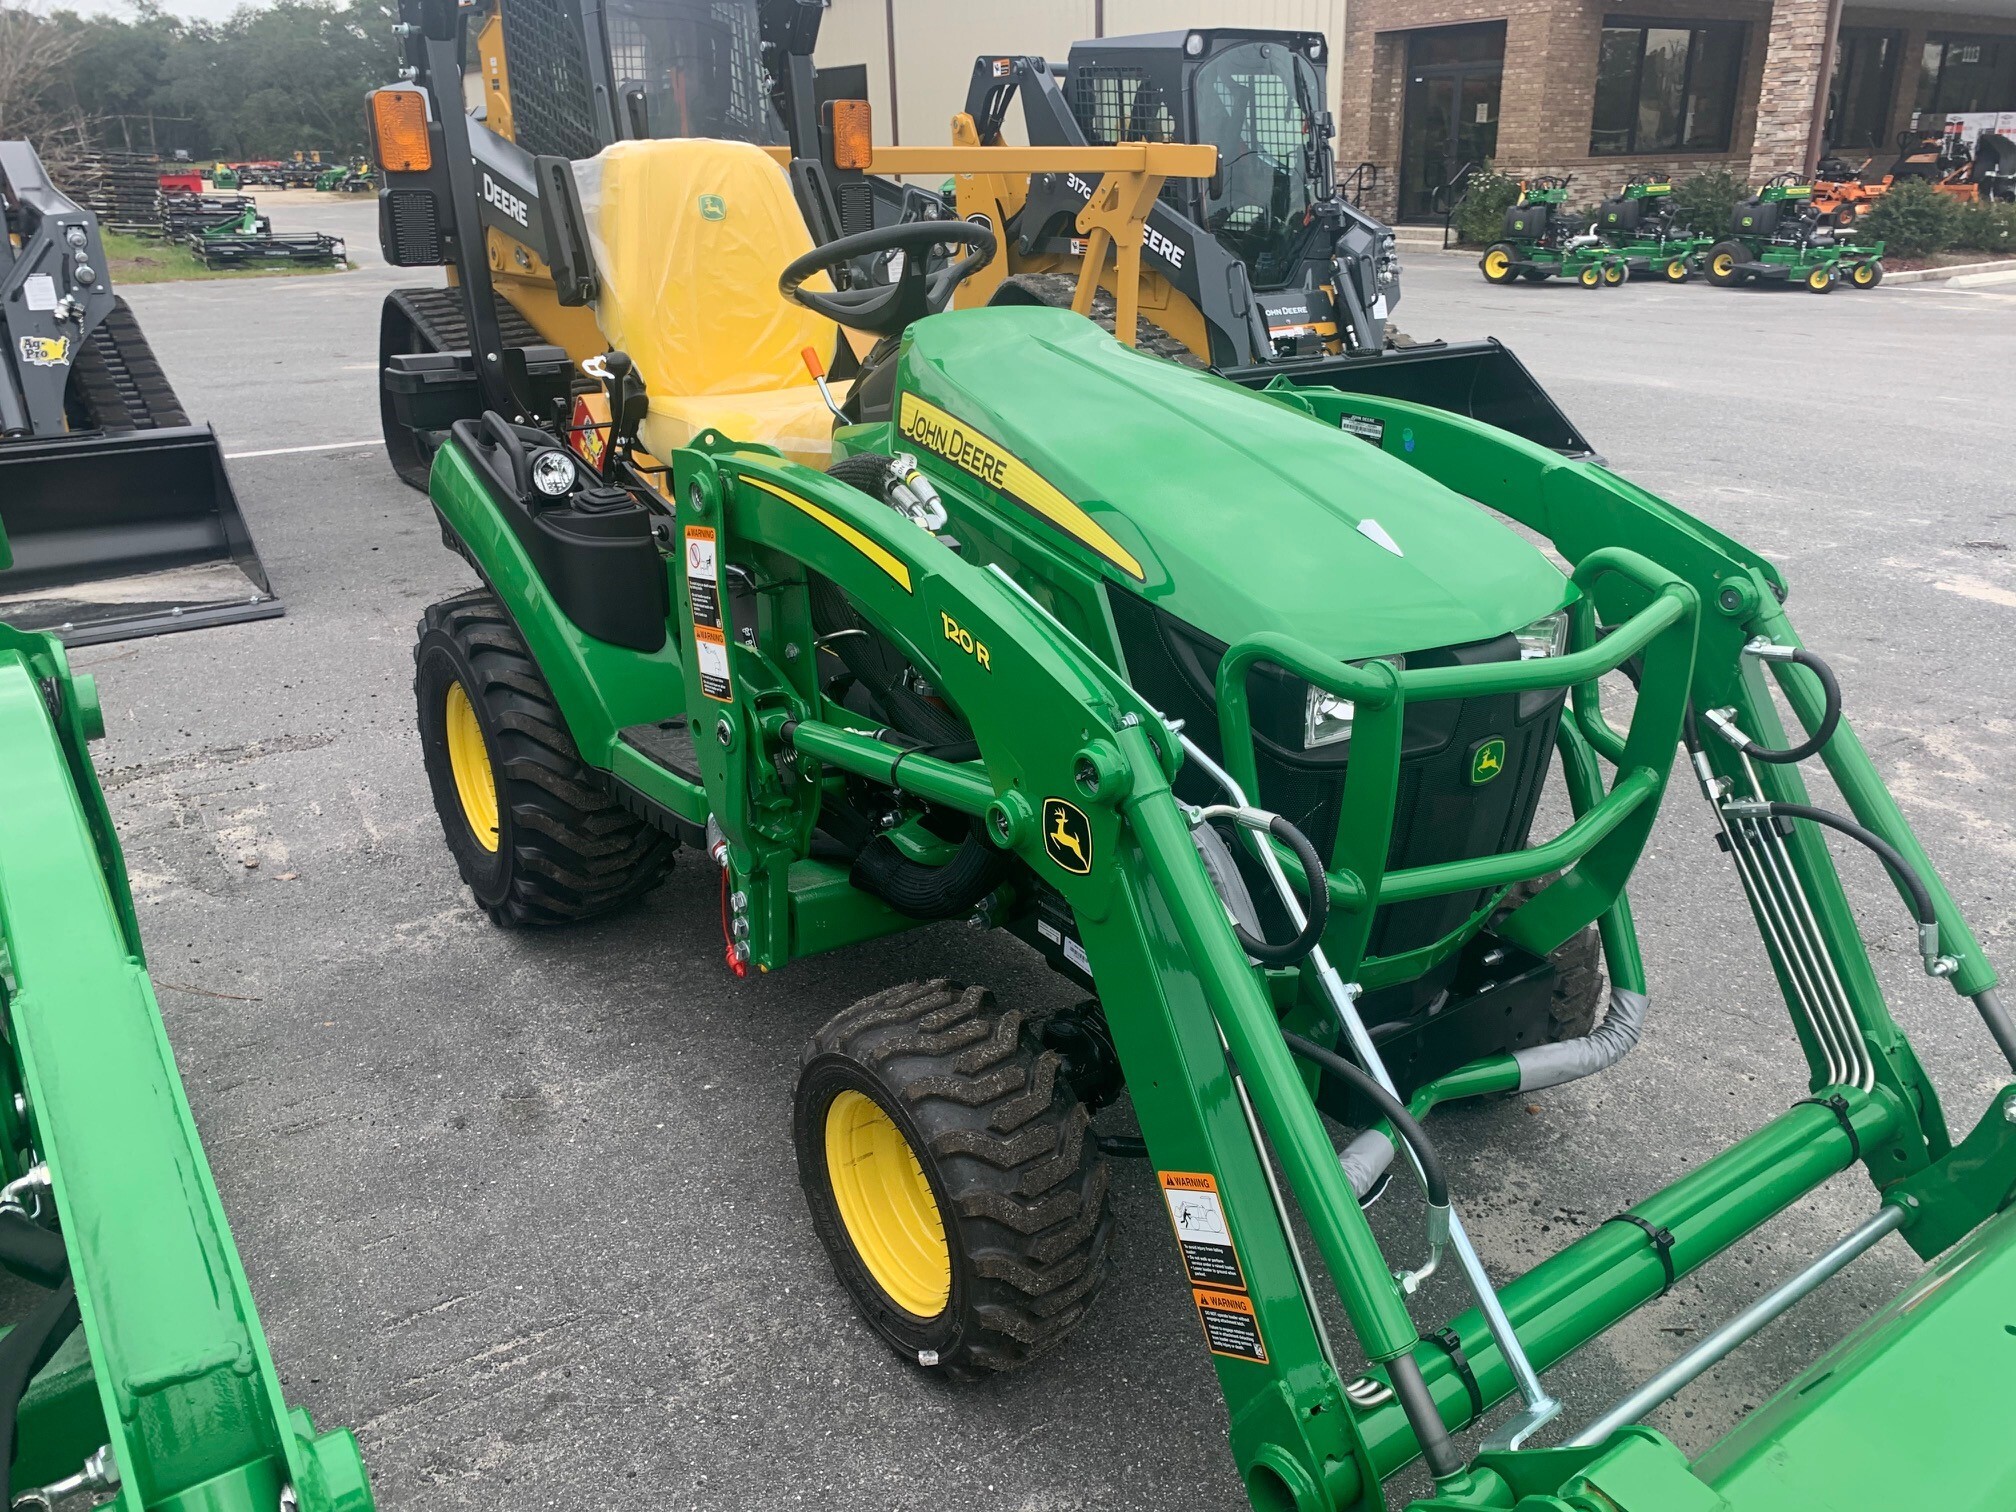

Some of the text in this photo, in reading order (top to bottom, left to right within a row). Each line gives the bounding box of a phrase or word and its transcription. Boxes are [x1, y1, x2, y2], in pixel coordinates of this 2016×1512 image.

[1066, 173, 1092, 200] 317G
[483, 172, 528, 228] DEERE
[1143, 223, 1185, 269] EERE
[1265, 306, 1308, 317] OHN DEERE
[26, 349, 48, 359] Pro
[906, 409, 1008, 486] JOHN DEERE
[690, 528, 715, 539] WARNING
[1174, 1176, 1210, 1188] WARNING
[1210, 1296, 1247, 1311] WARNING
